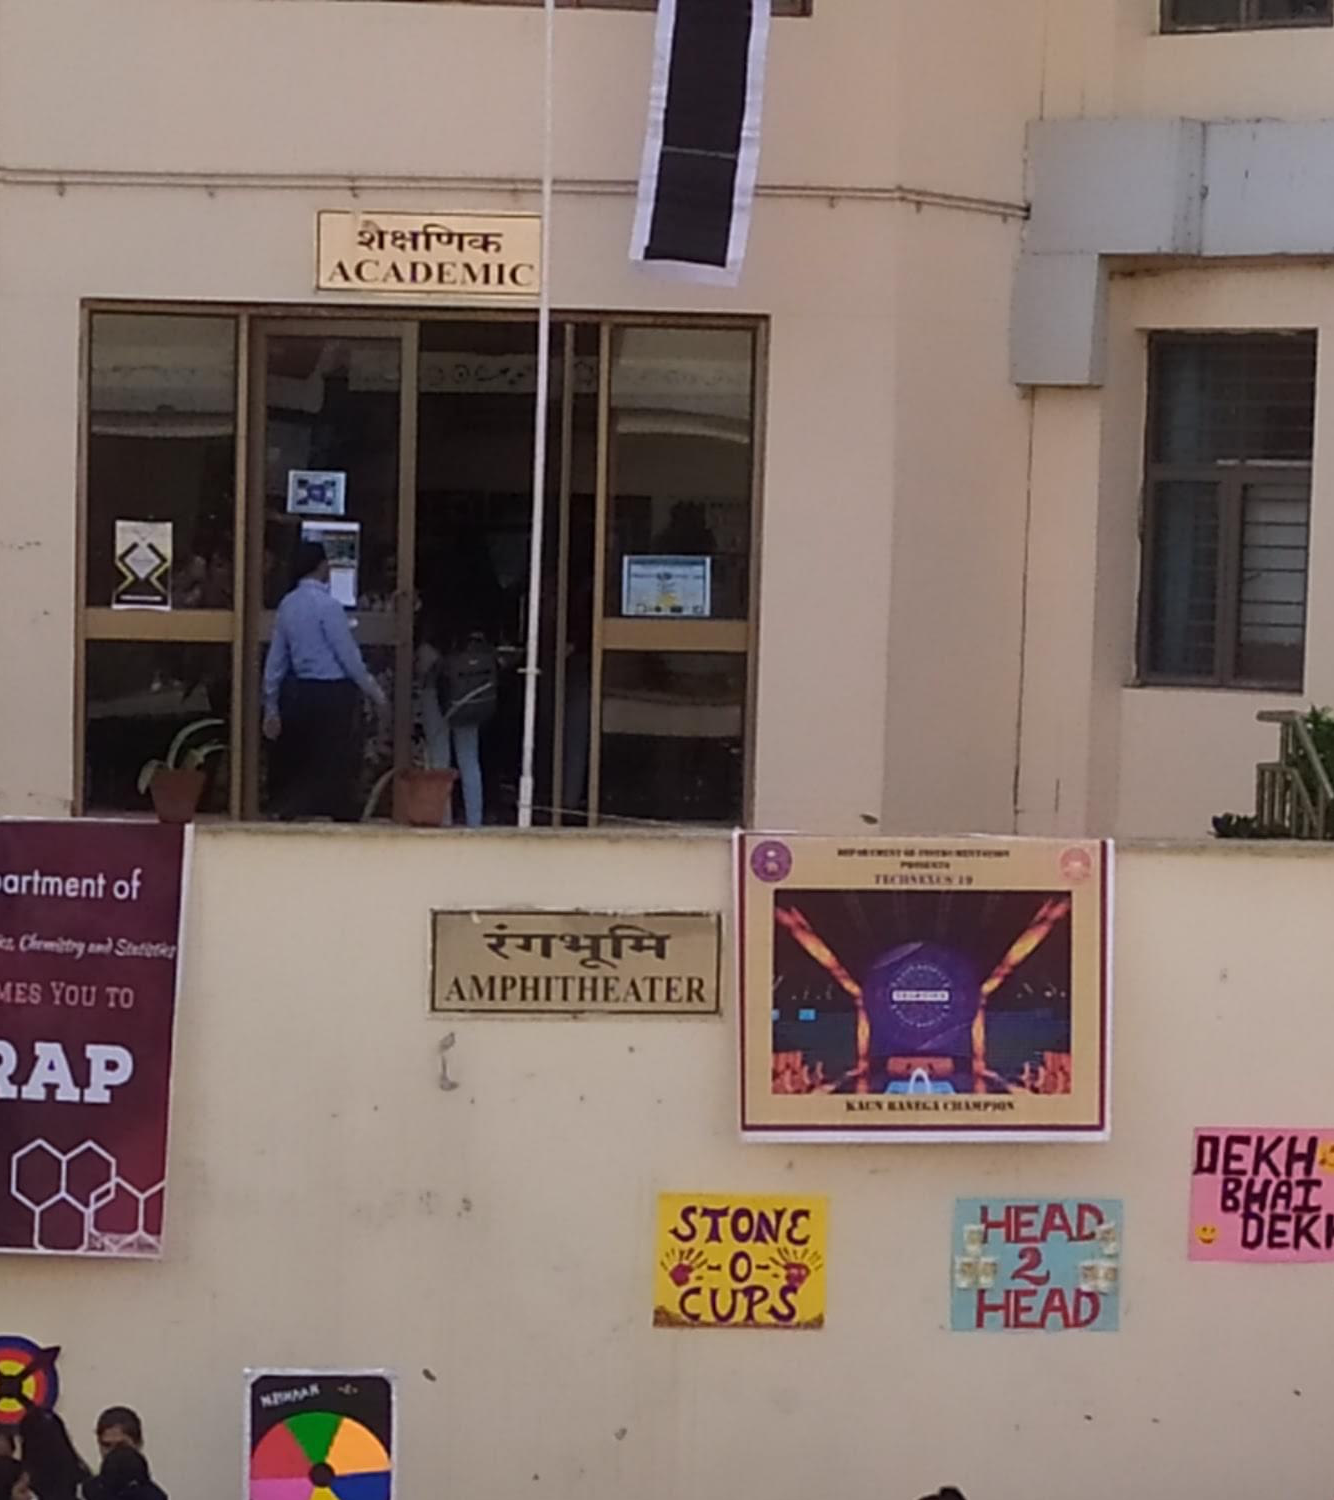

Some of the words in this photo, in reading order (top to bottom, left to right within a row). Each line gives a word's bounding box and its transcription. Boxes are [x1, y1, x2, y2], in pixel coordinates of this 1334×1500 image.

[328, 259, 535, 287] ACADEMIC
[113, 868, 142, 899] of
[87, 936, 113, 954] and
[483, 923, 671, 969] रंगभूमि
[50, 981, 96, 1007] YOU
[105, 987, 134, 1009] TO
[445, 974, 707, 1002] AMPHITHEATER
[846, 1100, 883, 1112] KAUN
[943, 1100, 1015, 1112] CHAMPION
[1192, 1135, 1319, 1178] DEKH
[1220, 1177, 1323, 1213] BHAI
[668, 1205, 811, 1246] STONE
[980, 1203, 1105, 1244] HEAD
[1011, 1246, 1051, 1286] 2
[679, 1284, 798, 1322] CUPS
[975, 1287, 1101, 1329] HEAD
